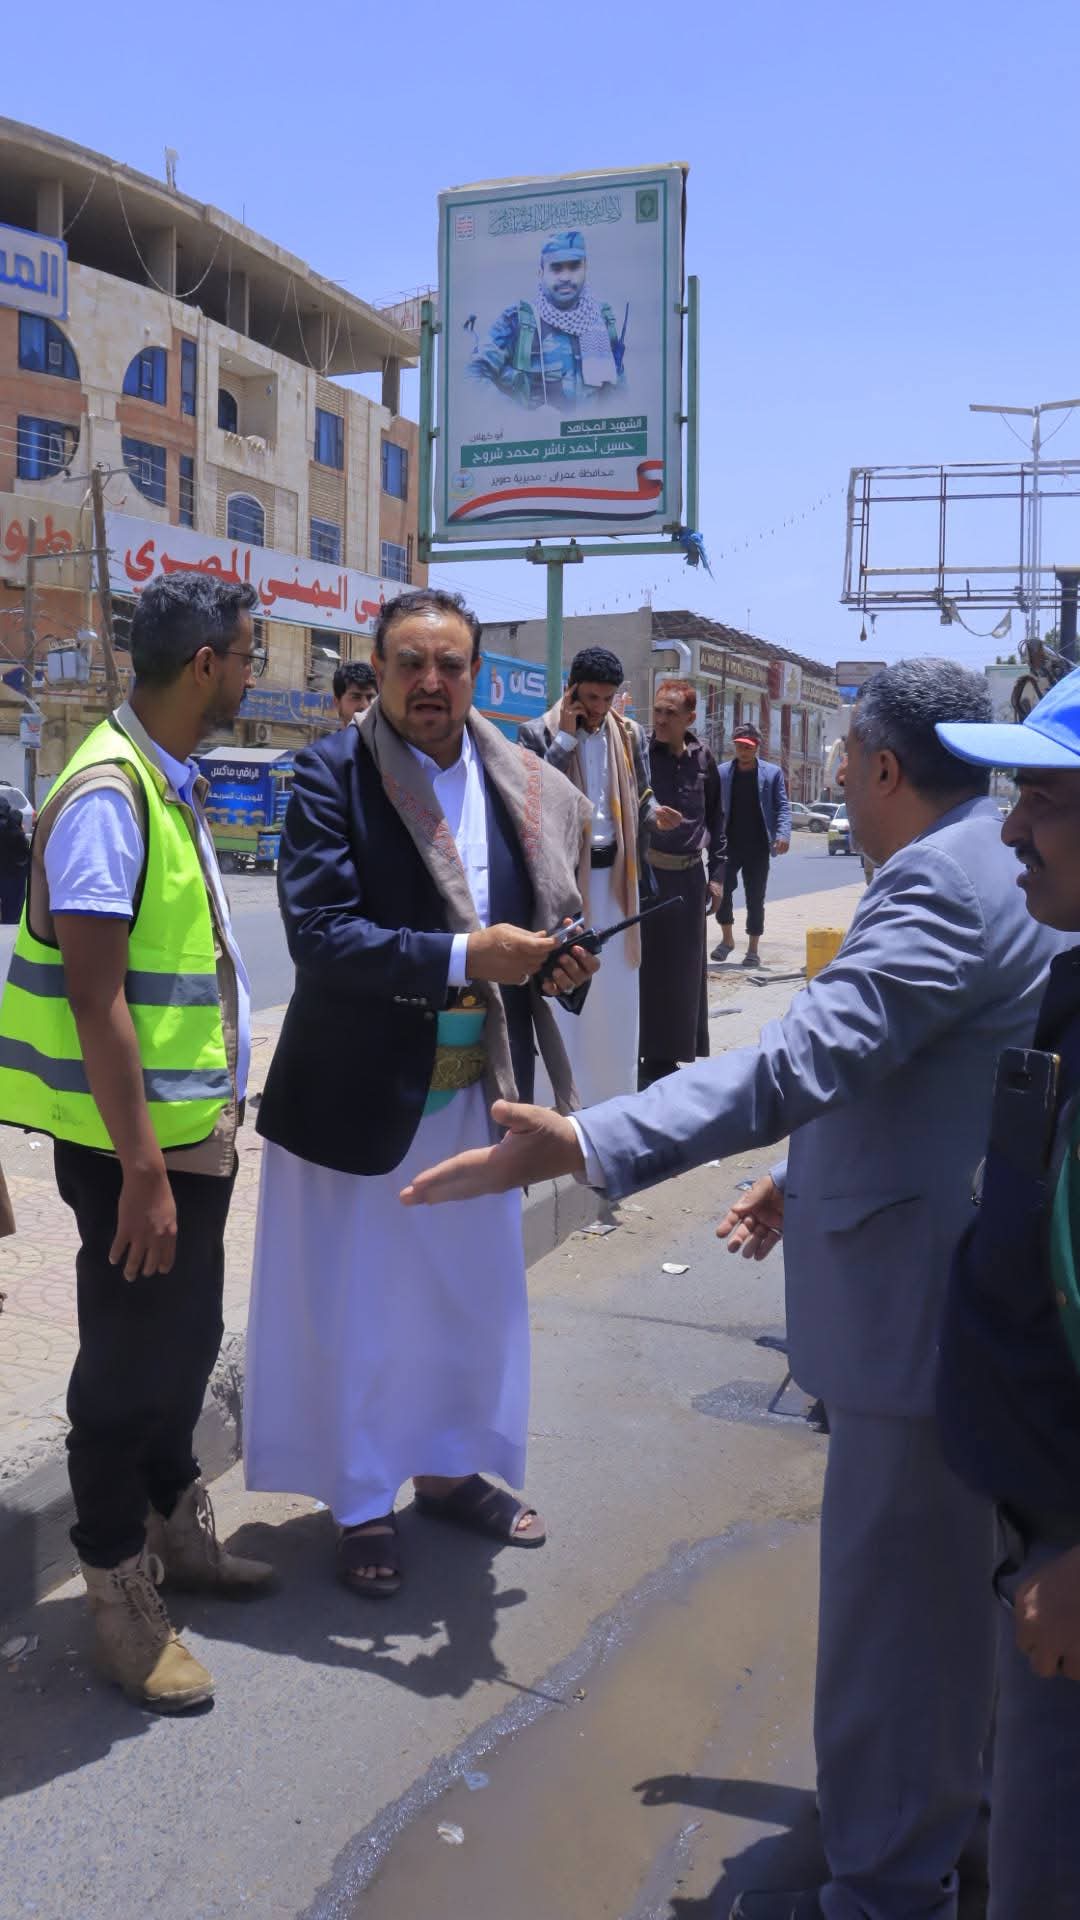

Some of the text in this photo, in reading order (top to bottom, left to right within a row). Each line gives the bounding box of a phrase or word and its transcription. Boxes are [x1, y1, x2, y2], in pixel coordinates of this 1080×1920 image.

[567, 418, 642, 434] الشهيد المجاهد
[506, 448, 540, 458] محمد
[543, 443, 565, 459] ناشر
[568, 437, 598, 454] أحمد
[600, 441, 635, 455] حسين
[513, 473, 542, 484] مديرية
[549, 471, 577, 482] عمران
[578, 467, 615, 479] محافظة
[124, 539, 252, 594] المصري
[258, 566, 348, 617] اليمني
